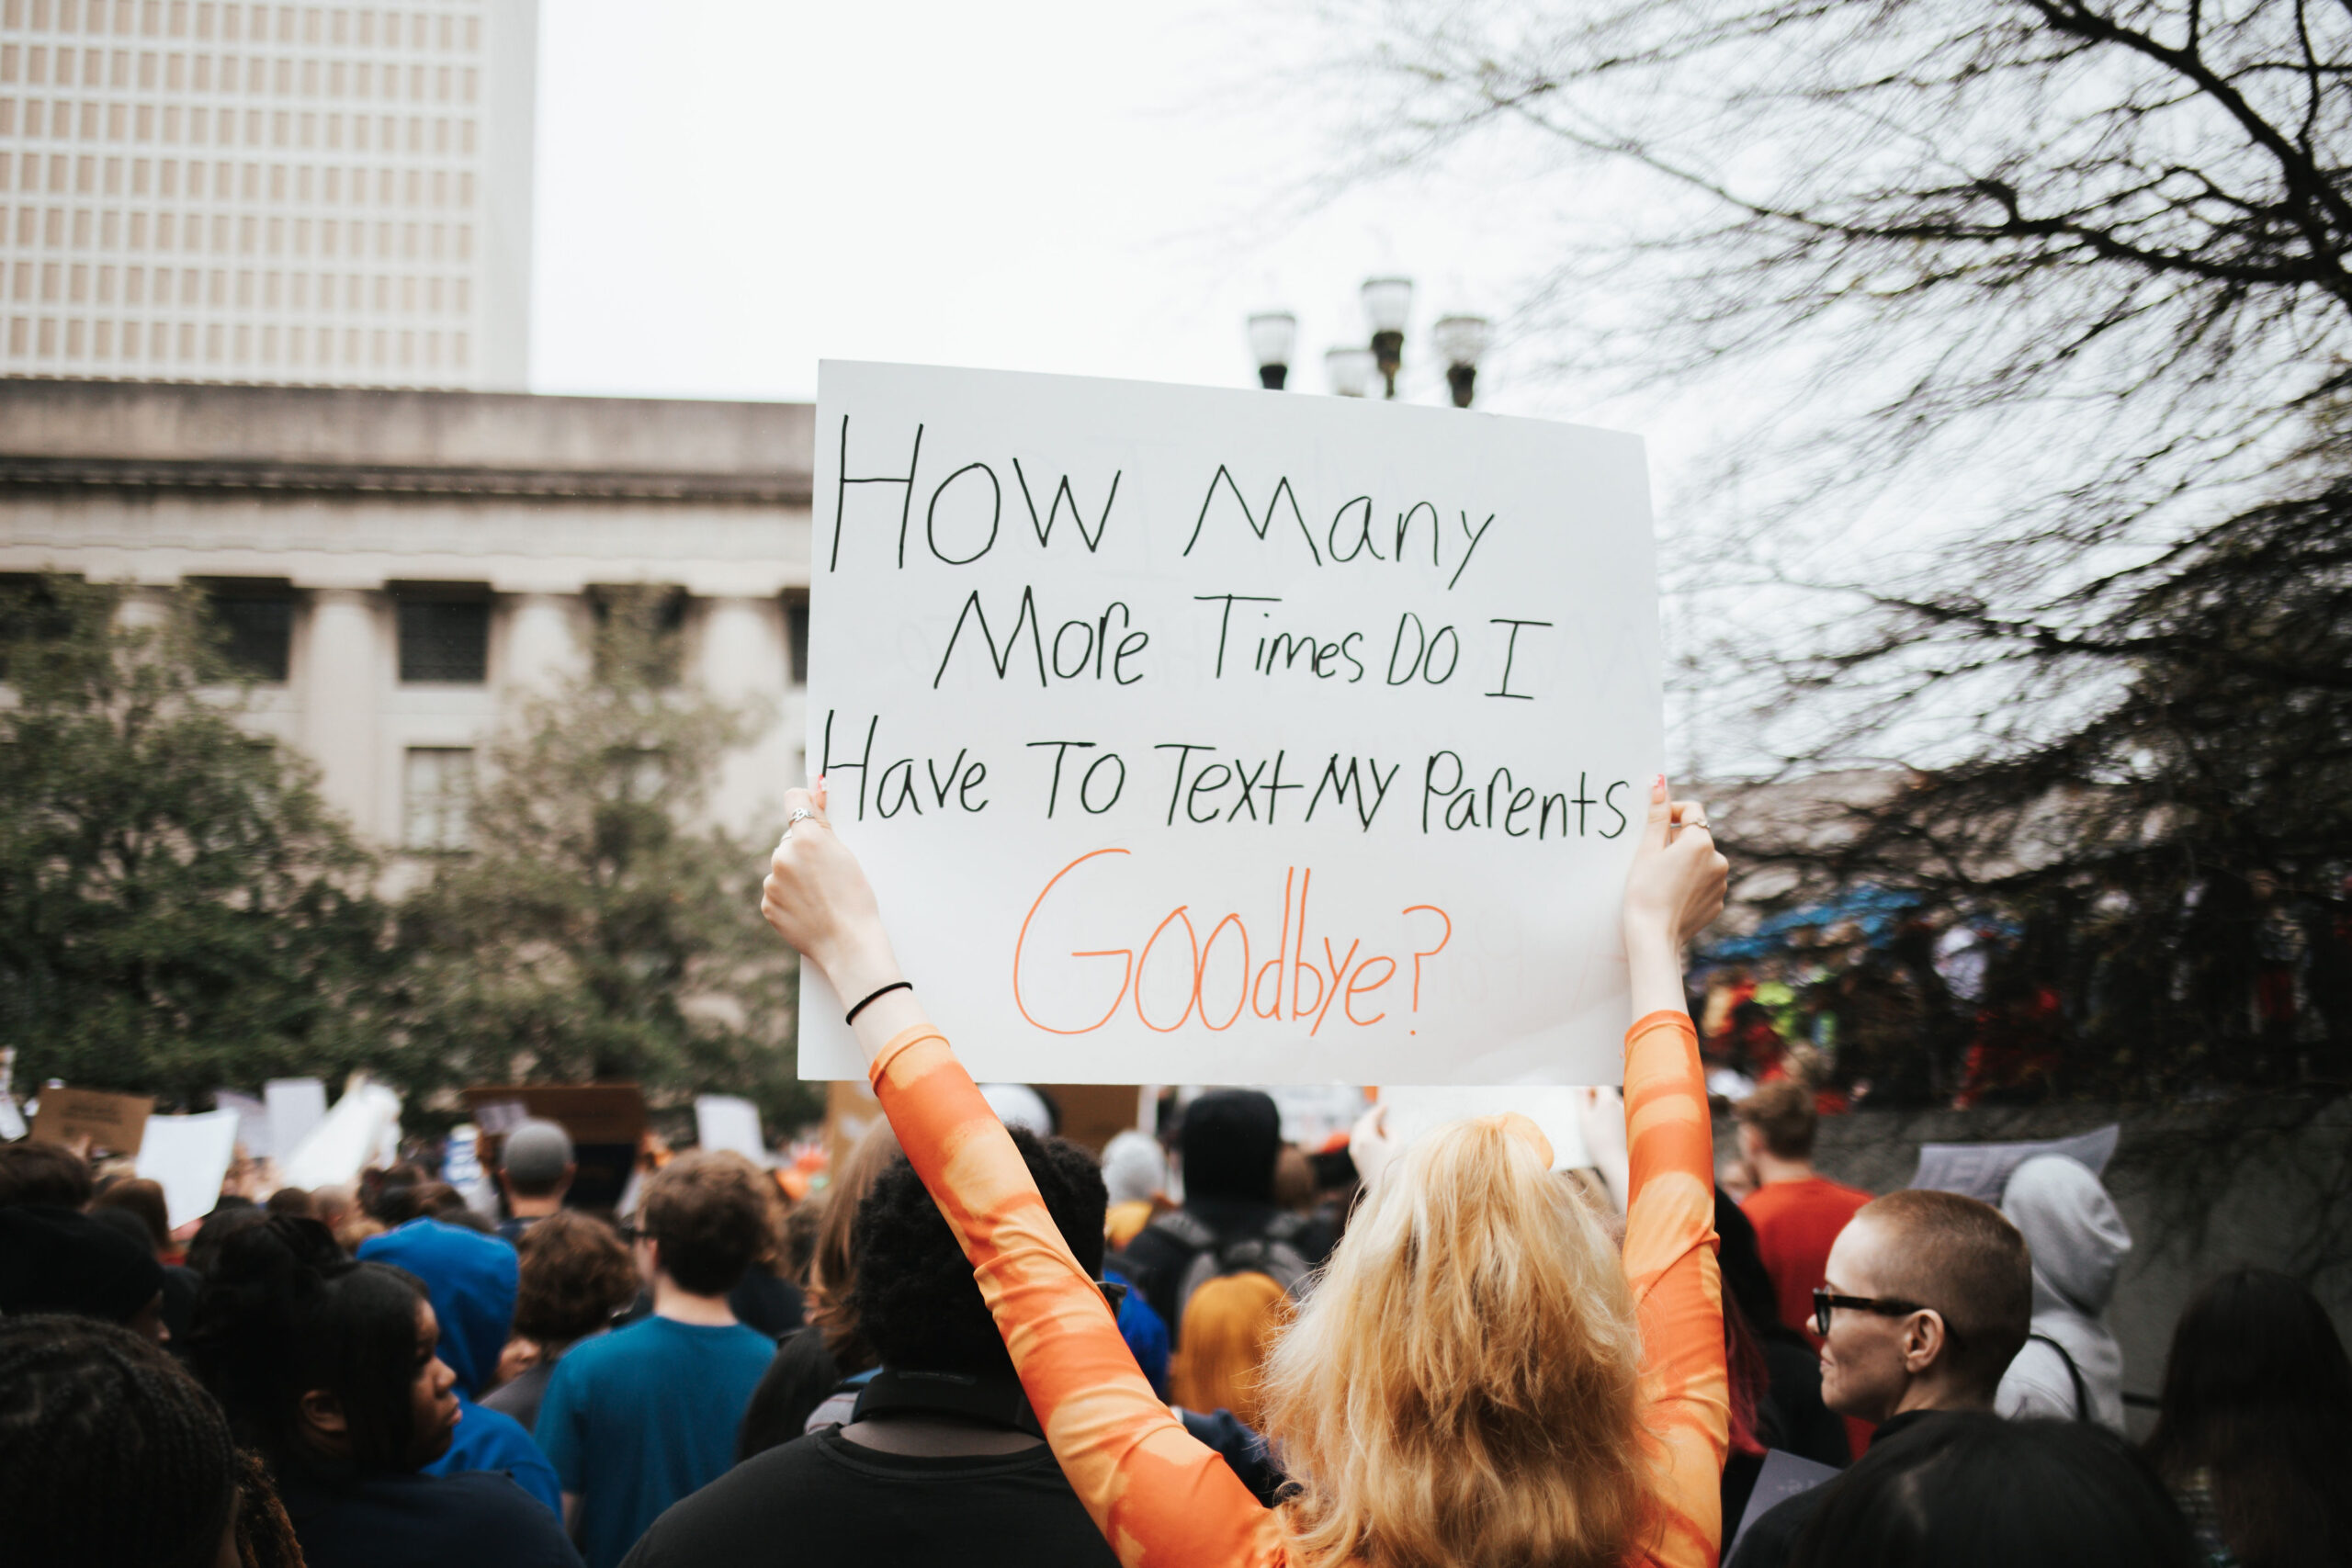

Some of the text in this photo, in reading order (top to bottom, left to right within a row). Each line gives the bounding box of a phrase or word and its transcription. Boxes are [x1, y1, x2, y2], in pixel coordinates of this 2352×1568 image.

[1182, 464, 1495, 590] Many
[933, 584, 1149, 690] More
[1194, 593, 1364, 683] Times
[1485, 618, 1553, 700] I
[821, 709, 989, 821] Have
[1154, 743, 1304, 826] Text
[1422, 750, 1628, 840] Parents
